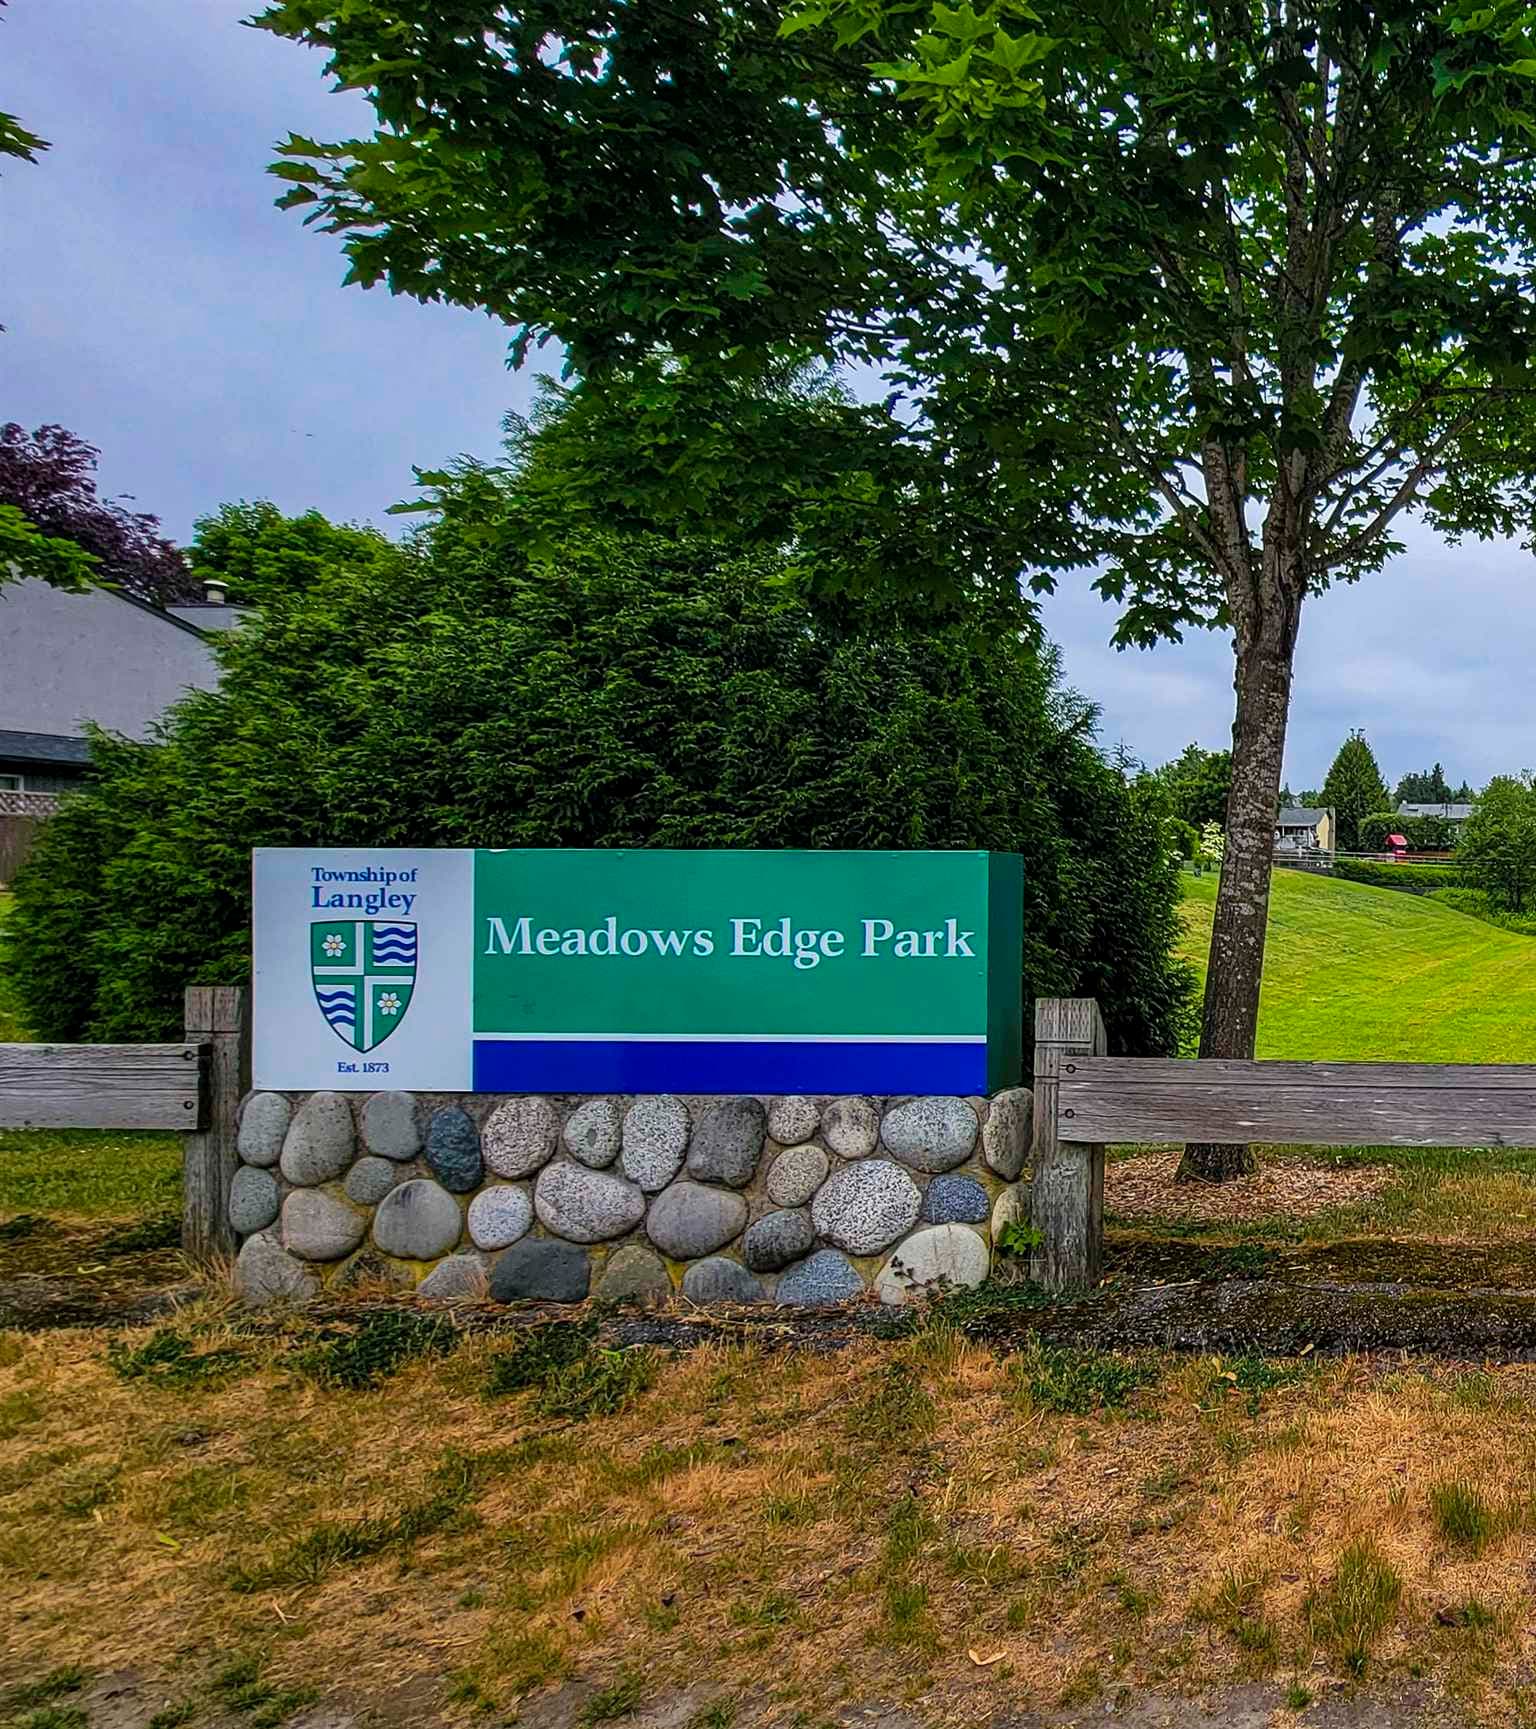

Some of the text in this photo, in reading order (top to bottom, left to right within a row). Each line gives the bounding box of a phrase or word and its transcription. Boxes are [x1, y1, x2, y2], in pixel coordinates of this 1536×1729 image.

[311, 866, 419, 886] Township of
[311, 885, 418, 916] Langley
[484, 916, 976, 970] Meadows Edge Park
[337, 1061, 390, 1074] Est. 1873
